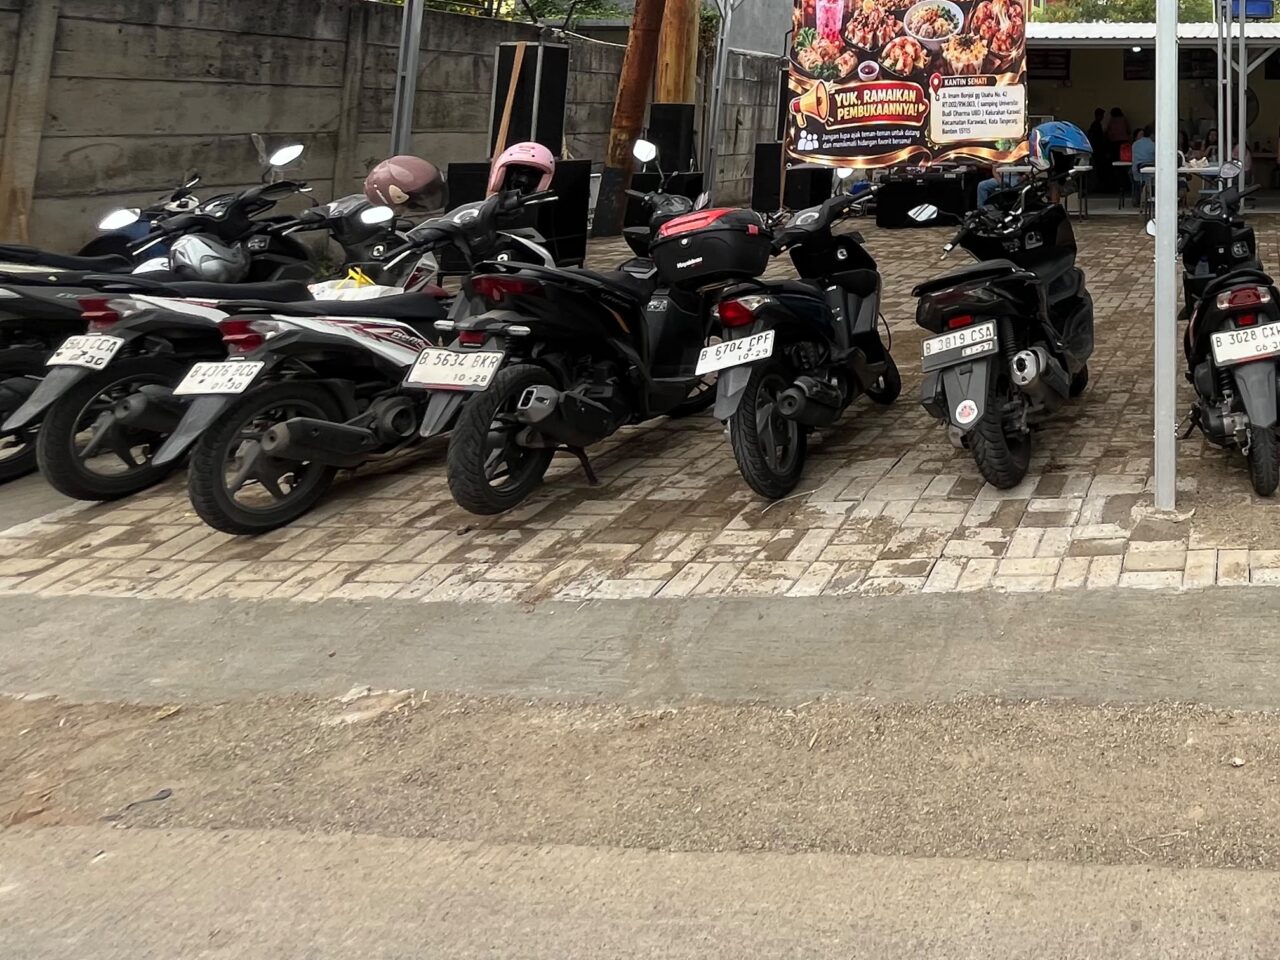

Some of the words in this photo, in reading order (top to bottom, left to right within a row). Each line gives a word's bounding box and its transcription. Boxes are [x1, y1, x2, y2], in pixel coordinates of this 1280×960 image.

[944, 79, 967, 87] KANTIN
[967, 77, 987, 86] SEHATI
[834, 90, 861, 107] YUK,
[863, 88, 916, 104] RAMAIKAN
[837, 103, 918, 121] PEMBUKAANNYA!
[925, 342, 931, 355] B
[938, 333, 966, 351] 3819
[970, 326, 992, 341] CSA
[1215, 336, 1222, 348] B
[1228, 330, 1257, 345] 3028
[419, 352, 430, 365] B
[471, 354, 499, 369] BKR
[700, 350, 708, 361] B
